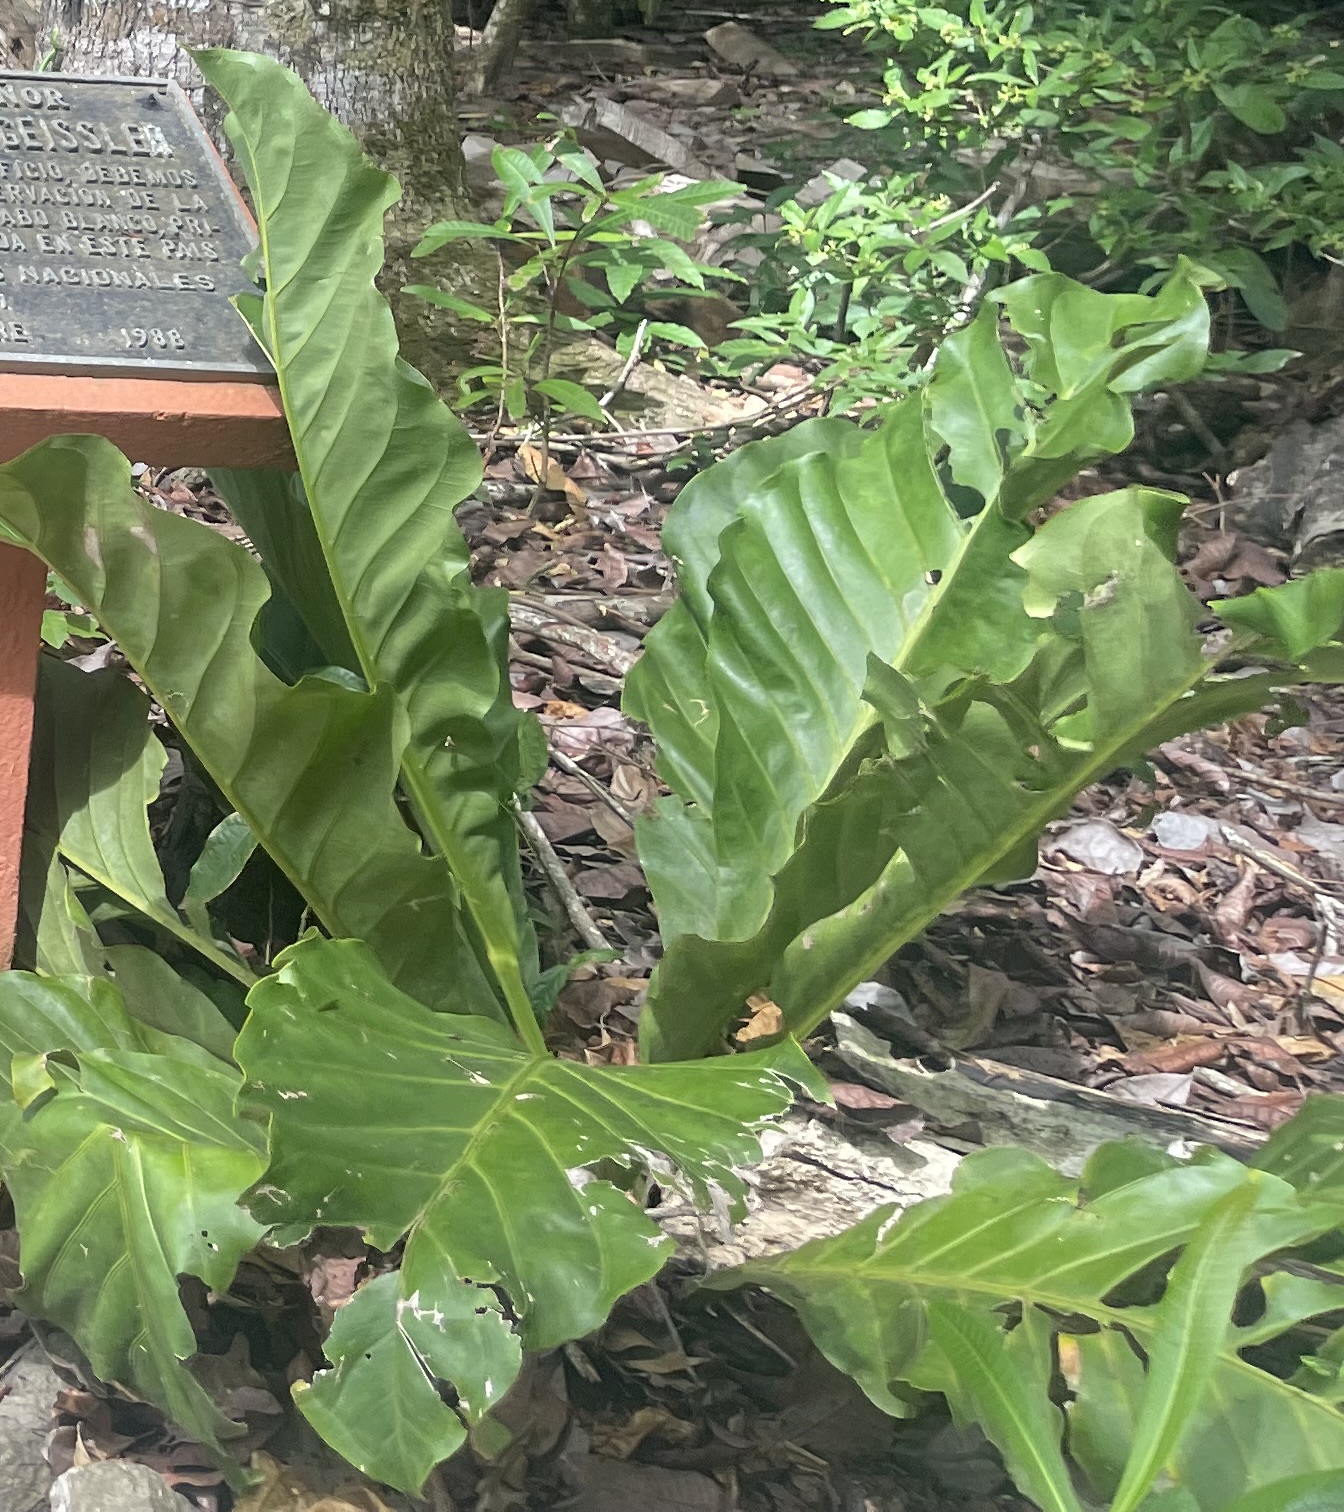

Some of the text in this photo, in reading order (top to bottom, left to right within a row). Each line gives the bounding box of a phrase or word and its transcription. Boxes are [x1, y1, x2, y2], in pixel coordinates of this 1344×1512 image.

[80, 162, 198, 188] DEBEMOS
[128, 189, 160, 211] DE
[171, 193, 209, 213] LA
[37, 233, 74, 255] EN
[80, 235, 151, 259] ESTE
[18, 264, 215, 291] NACIONALES
[120, 328, 186, 350] 1988
